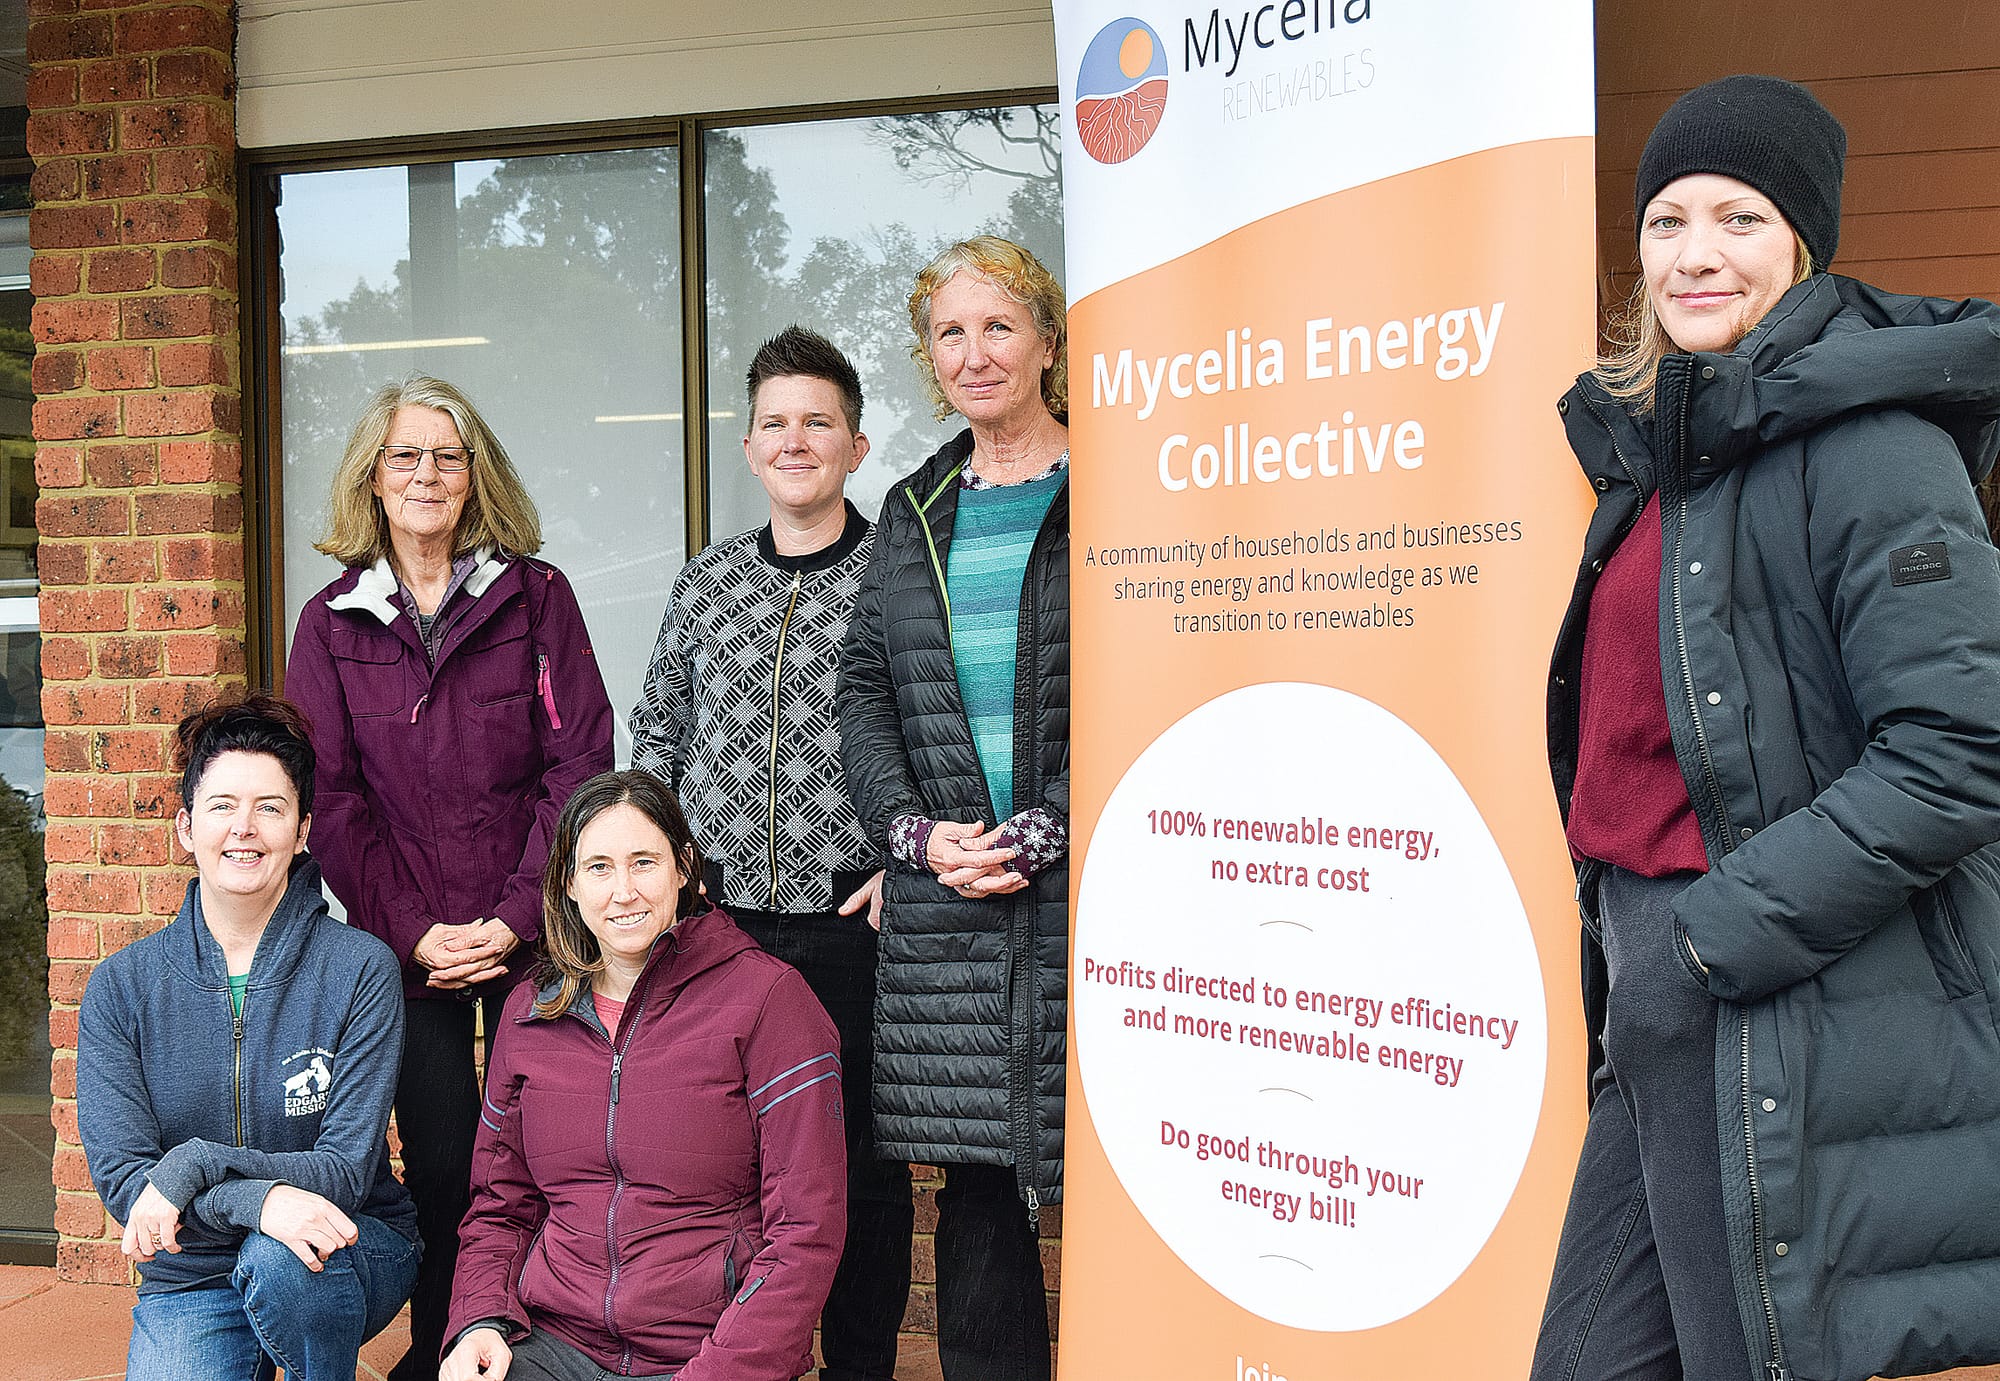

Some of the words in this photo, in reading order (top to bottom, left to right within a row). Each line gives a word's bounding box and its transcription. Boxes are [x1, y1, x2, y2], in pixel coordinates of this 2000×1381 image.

[1223, 48, 1375, 125] RENEWABLES
[1092, 327, 1285, 421] Mycelia
[1305, 302, 1506, 382] Energy
[1157, 410, 1425, 493] Collective
[1085, 546, 1096, 568] A
[1100, 539, 1206, 568] community
[1211, 536, 1230, 560] of
[1234, 528, 1350, 558] households
[1356, 523, 1396, 551] and
[1403, 520, 1522, 549] businesses
[1899, 561, 1942, 574] macpac
[1114, 576, 1185, 604] sharing
[1191, 576, 1252, 602] energy
[1257, 568, 1294, 594] and
[1302, 563, 1415, 595] knowledge
[1421, 566, 1443, 587] as
[1448, 564, 1479, 585] we
[1173, 609, 1261, 633] transition
[1267, 609, 1287, 631] to
[1294, 602, 1415, 630] renewables
[1147, 809, 1206, 837] 100%
[1213, 816, 1339, 846] renewable
[1347, 826, 1440, 861] energy,
[1211, 859, 1239, 881] no
[1246, 861, 1308, 887] extra
[1317, 867, 1370, 893] cost
[1085, 957, 1156, 990] Profits
[1163, 966, 1255, 1004] directed
[1262, 982, 1288, 1008] to
[1295, 990, 1383, 1029] energy
[1390, 997, 1519, 1050] efficiency
[1123, 1005, 1166, 1032] and
[1174, 1013, 1232, 1042] more
[1239, 1024, 1370, 1063] renewable
[1378, 1044, 1464, 1088] energy
[284, 1091, 330, 1109] EDGAR'
[284, 1100, 328, 1118] MISSIO
[1161, 1120, 1190, 1149] Do
[1196, 1132, 1250, 1163] good
[1256, 1140, 1359, 1189] through
[1366, 1166, 1424, 1199] your
[1221, 1179, 1302, 1223] energy
[1309, 1191, 1356, 1228] bill!
[1235, 1354, 1289, 1381] Joi
